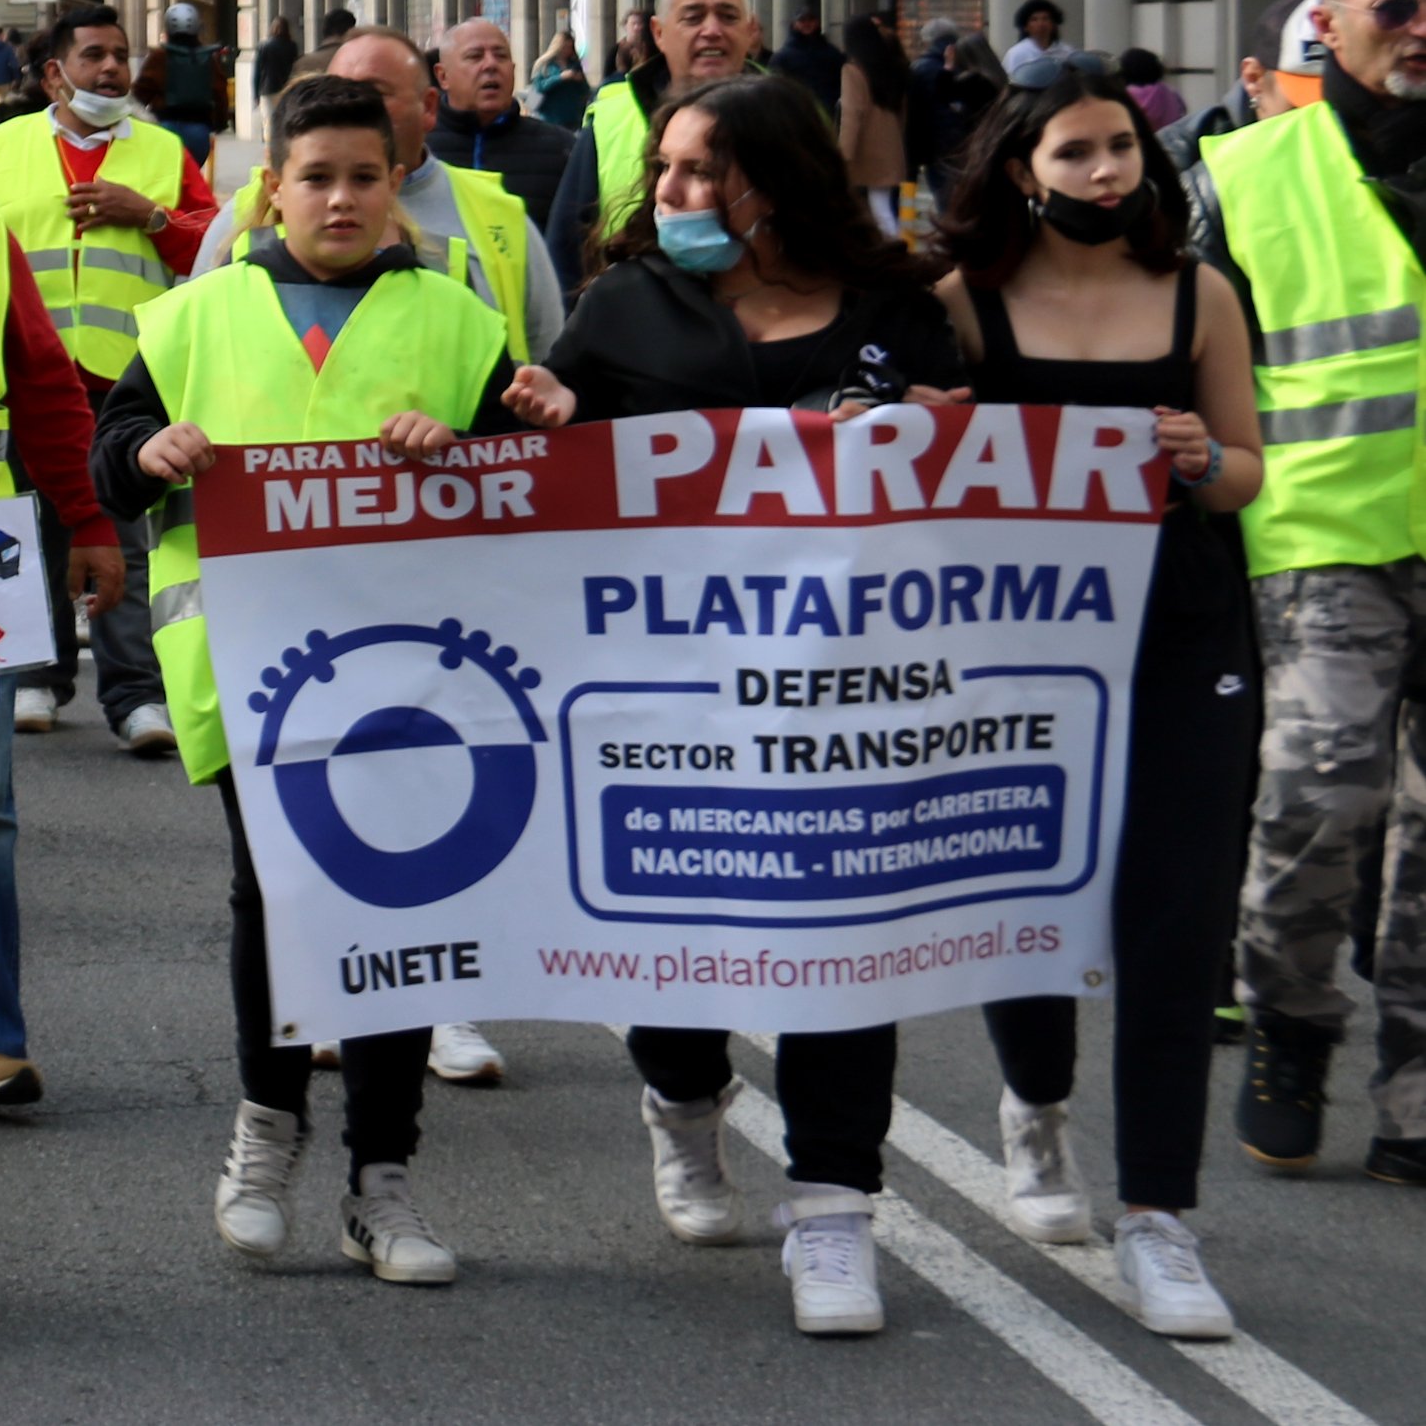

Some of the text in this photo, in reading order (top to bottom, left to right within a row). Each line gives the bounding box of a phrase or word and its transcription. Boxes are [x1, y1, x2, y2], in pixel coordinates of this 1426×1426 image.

[244, 444, 346, 474] PARA
[611, 403, 1160, 519] PARAR
[263, 470, 536, 533] MEJOR
[583, 564, 1116, 637] PLATAFORMA
[736, 659, 954, 708] DEFENSA
[599, 714, 1056, 774] SECTOR TRANSPORTE
[624, 785, 1051, 835] de MERCANCIAS por CARRETERA
[631, 846, 805, 879] NACIONAL
[833, 824, 1044, 877] INTERNACIONAL
[339, 940, 482, 995] ÚNETE
[536, 921, 1062, 991] www.plataformanacional.es
